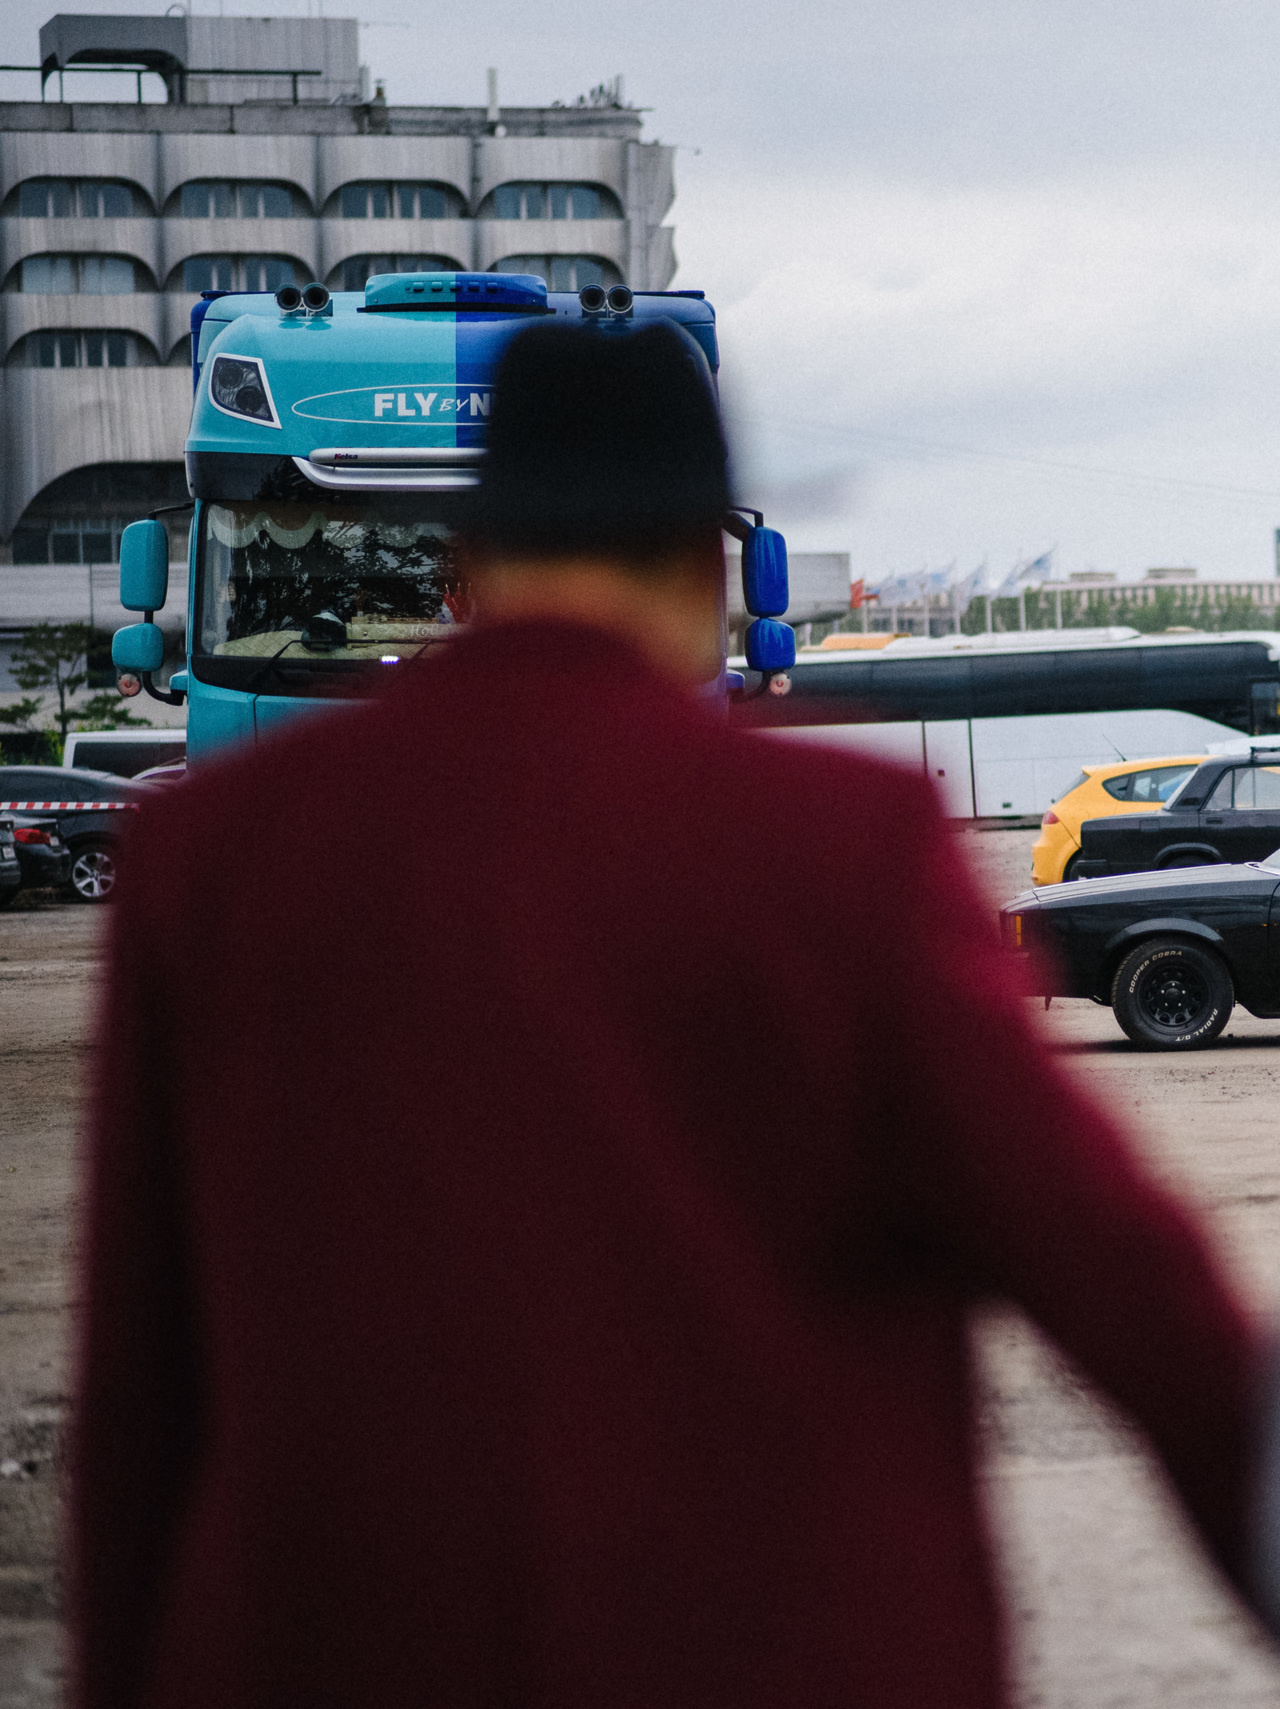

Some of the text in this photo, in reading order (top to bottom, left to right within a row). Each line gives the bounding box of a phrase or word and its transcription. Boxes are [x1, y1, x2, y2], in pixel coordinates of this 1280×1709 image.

[374, 392, 438, 417] FLY
[438, 398, 470, 412] BY
[1129, 950, 1182, 994] COOPER COBRA
[1193, 1008, 1218, 1036] RADIAL
